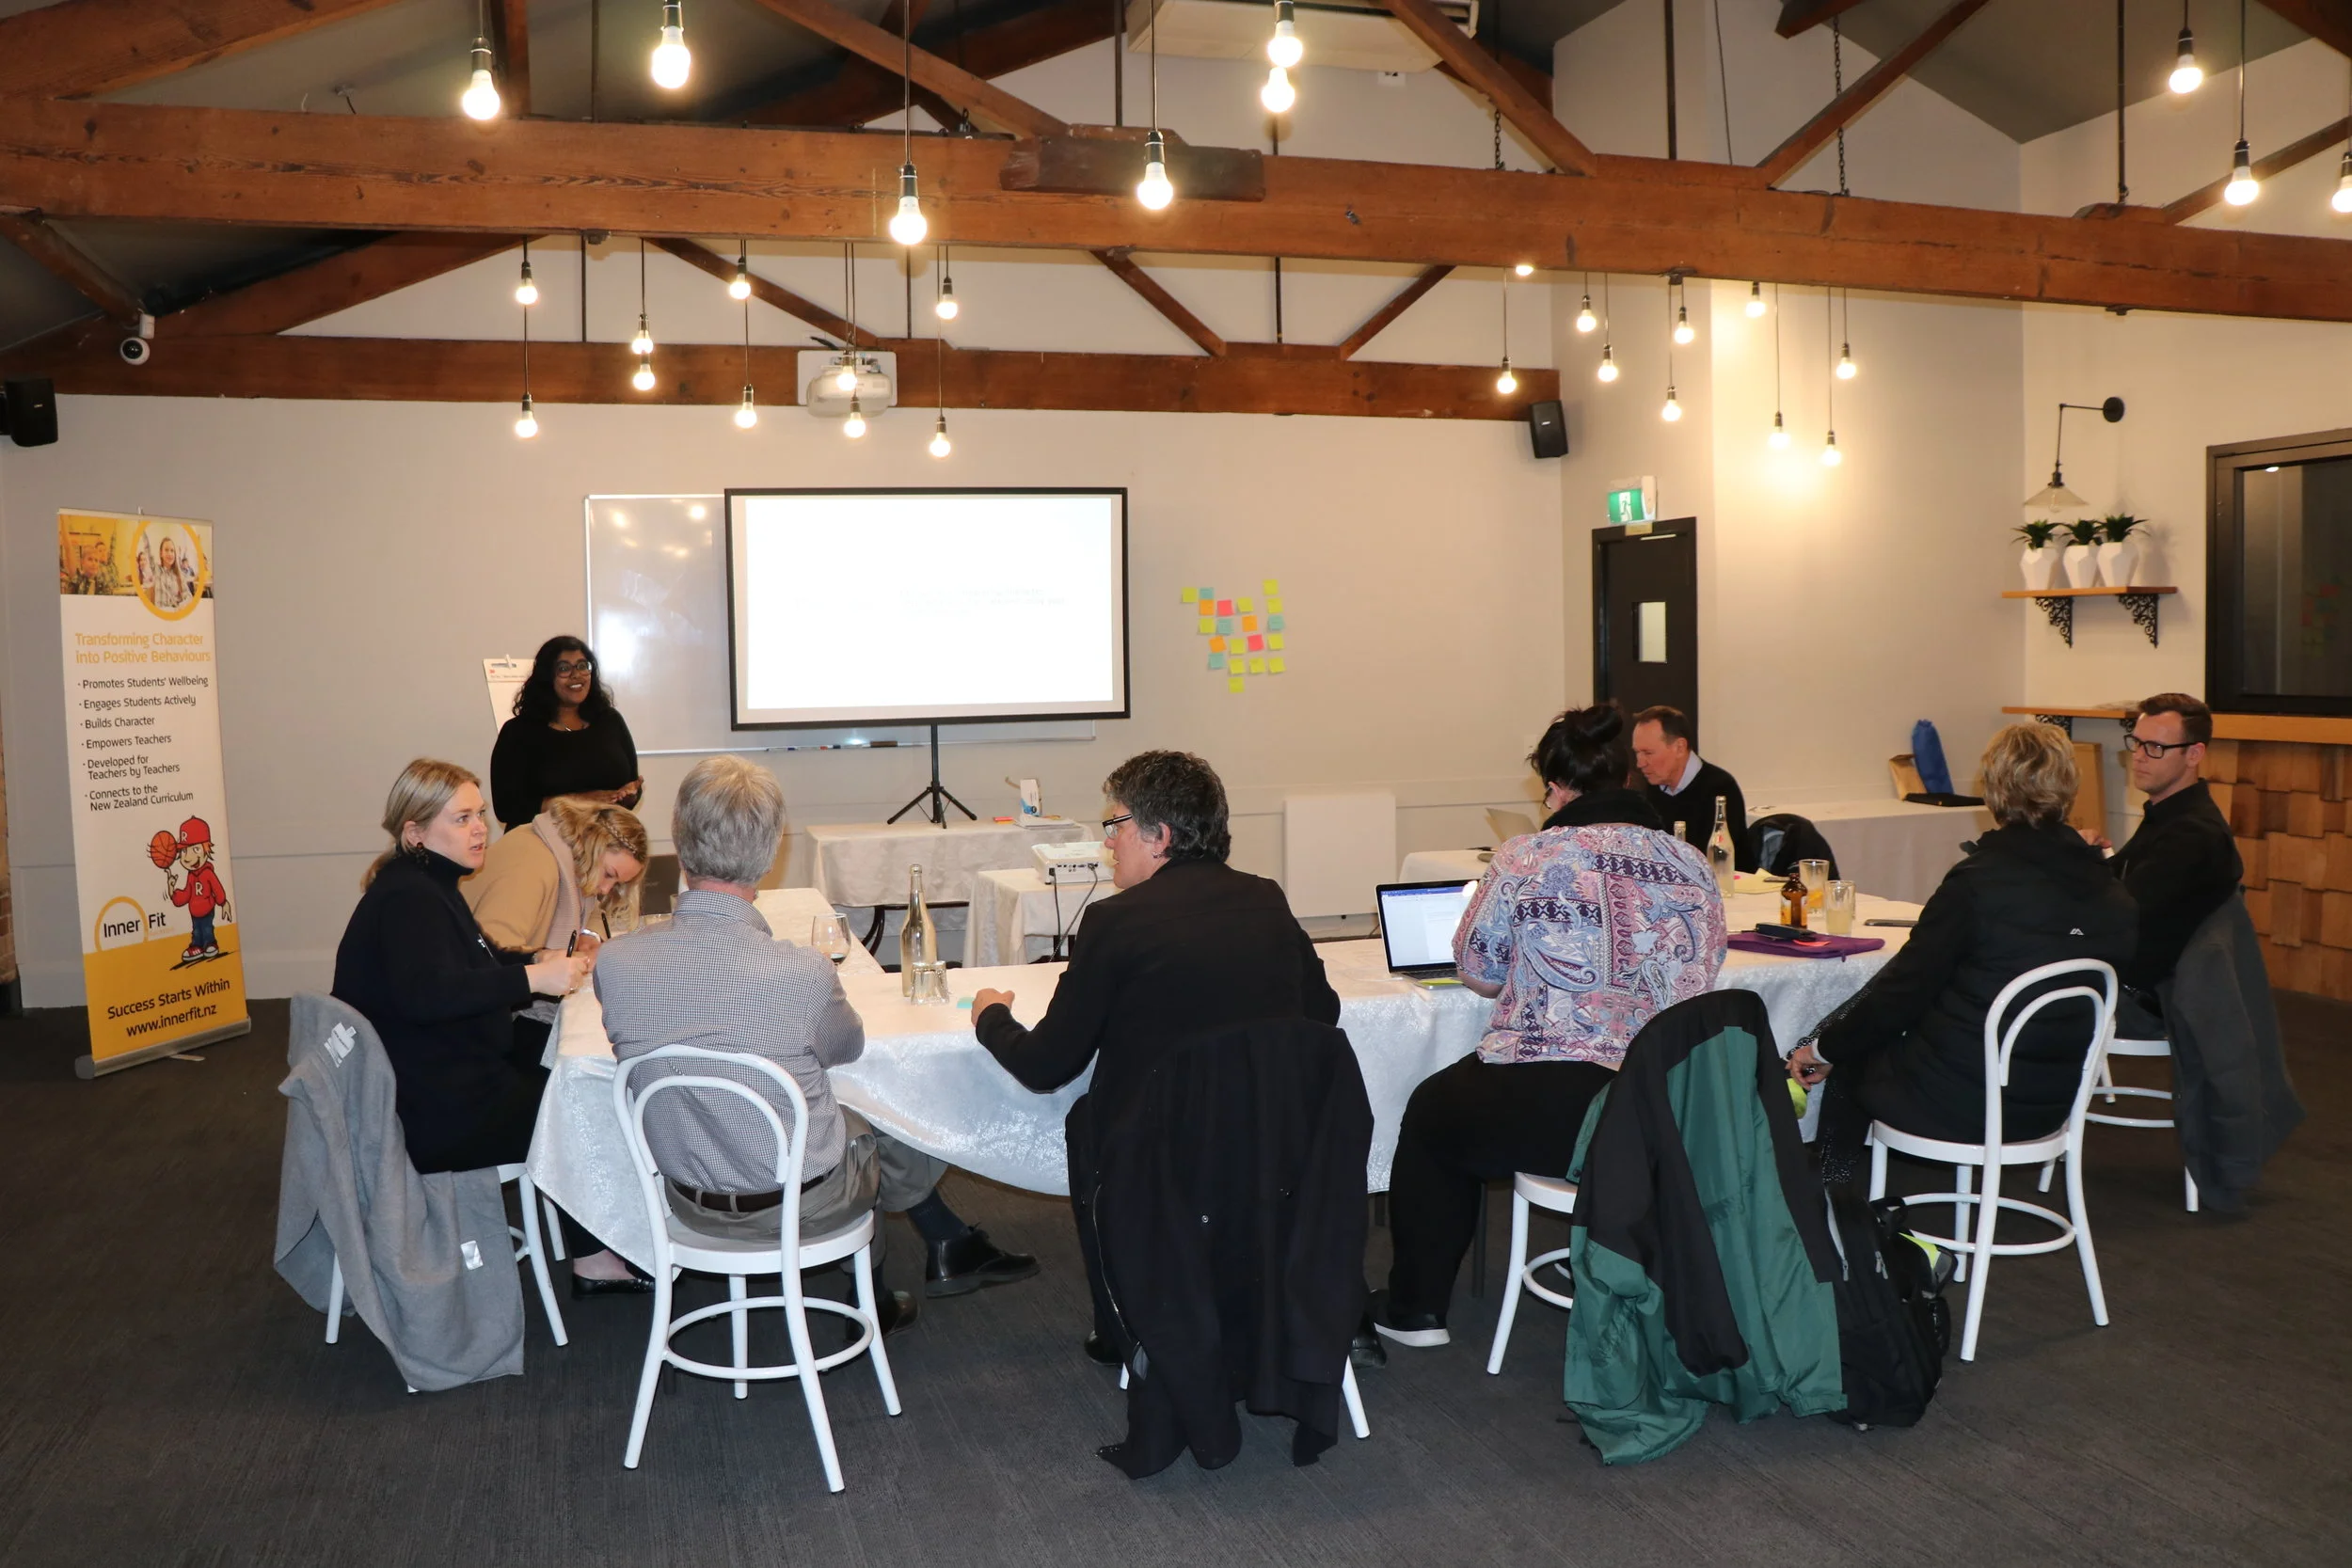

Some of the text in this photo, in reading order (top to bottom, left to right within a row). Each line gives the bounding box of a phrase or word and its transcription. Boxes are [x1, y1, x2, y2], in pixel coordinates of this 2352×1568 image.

[75, 632, 203, 649] Transforming Character
[76, 648, 211, 664] into Positive Behaviours
[83, 674, 209, 689] Promotes Students' Wellbeing
[84, 694, 197, 711] Engages Students Actively
[85, 717, 154, 729] Builds Character
[86, 734, 172, 751] Empowers Teachers
[87, 754, 149, 769] Developed for
[87, 763, 181, 781] Teachers by Teachers
[89, 784, 158, 800] Connects to the
[90, 791, 194, 812] New Zealand Curriculum
[181, 831, 188, 843] R
[195, 881, 203, 896] R
[103, 919, 141, 938] Inner
[148, 911, 167, 929] Fit
[107, 977, 230, 1020] Success Starts Within
[126, 1004, 217, 1037] www.innerfit.nz
